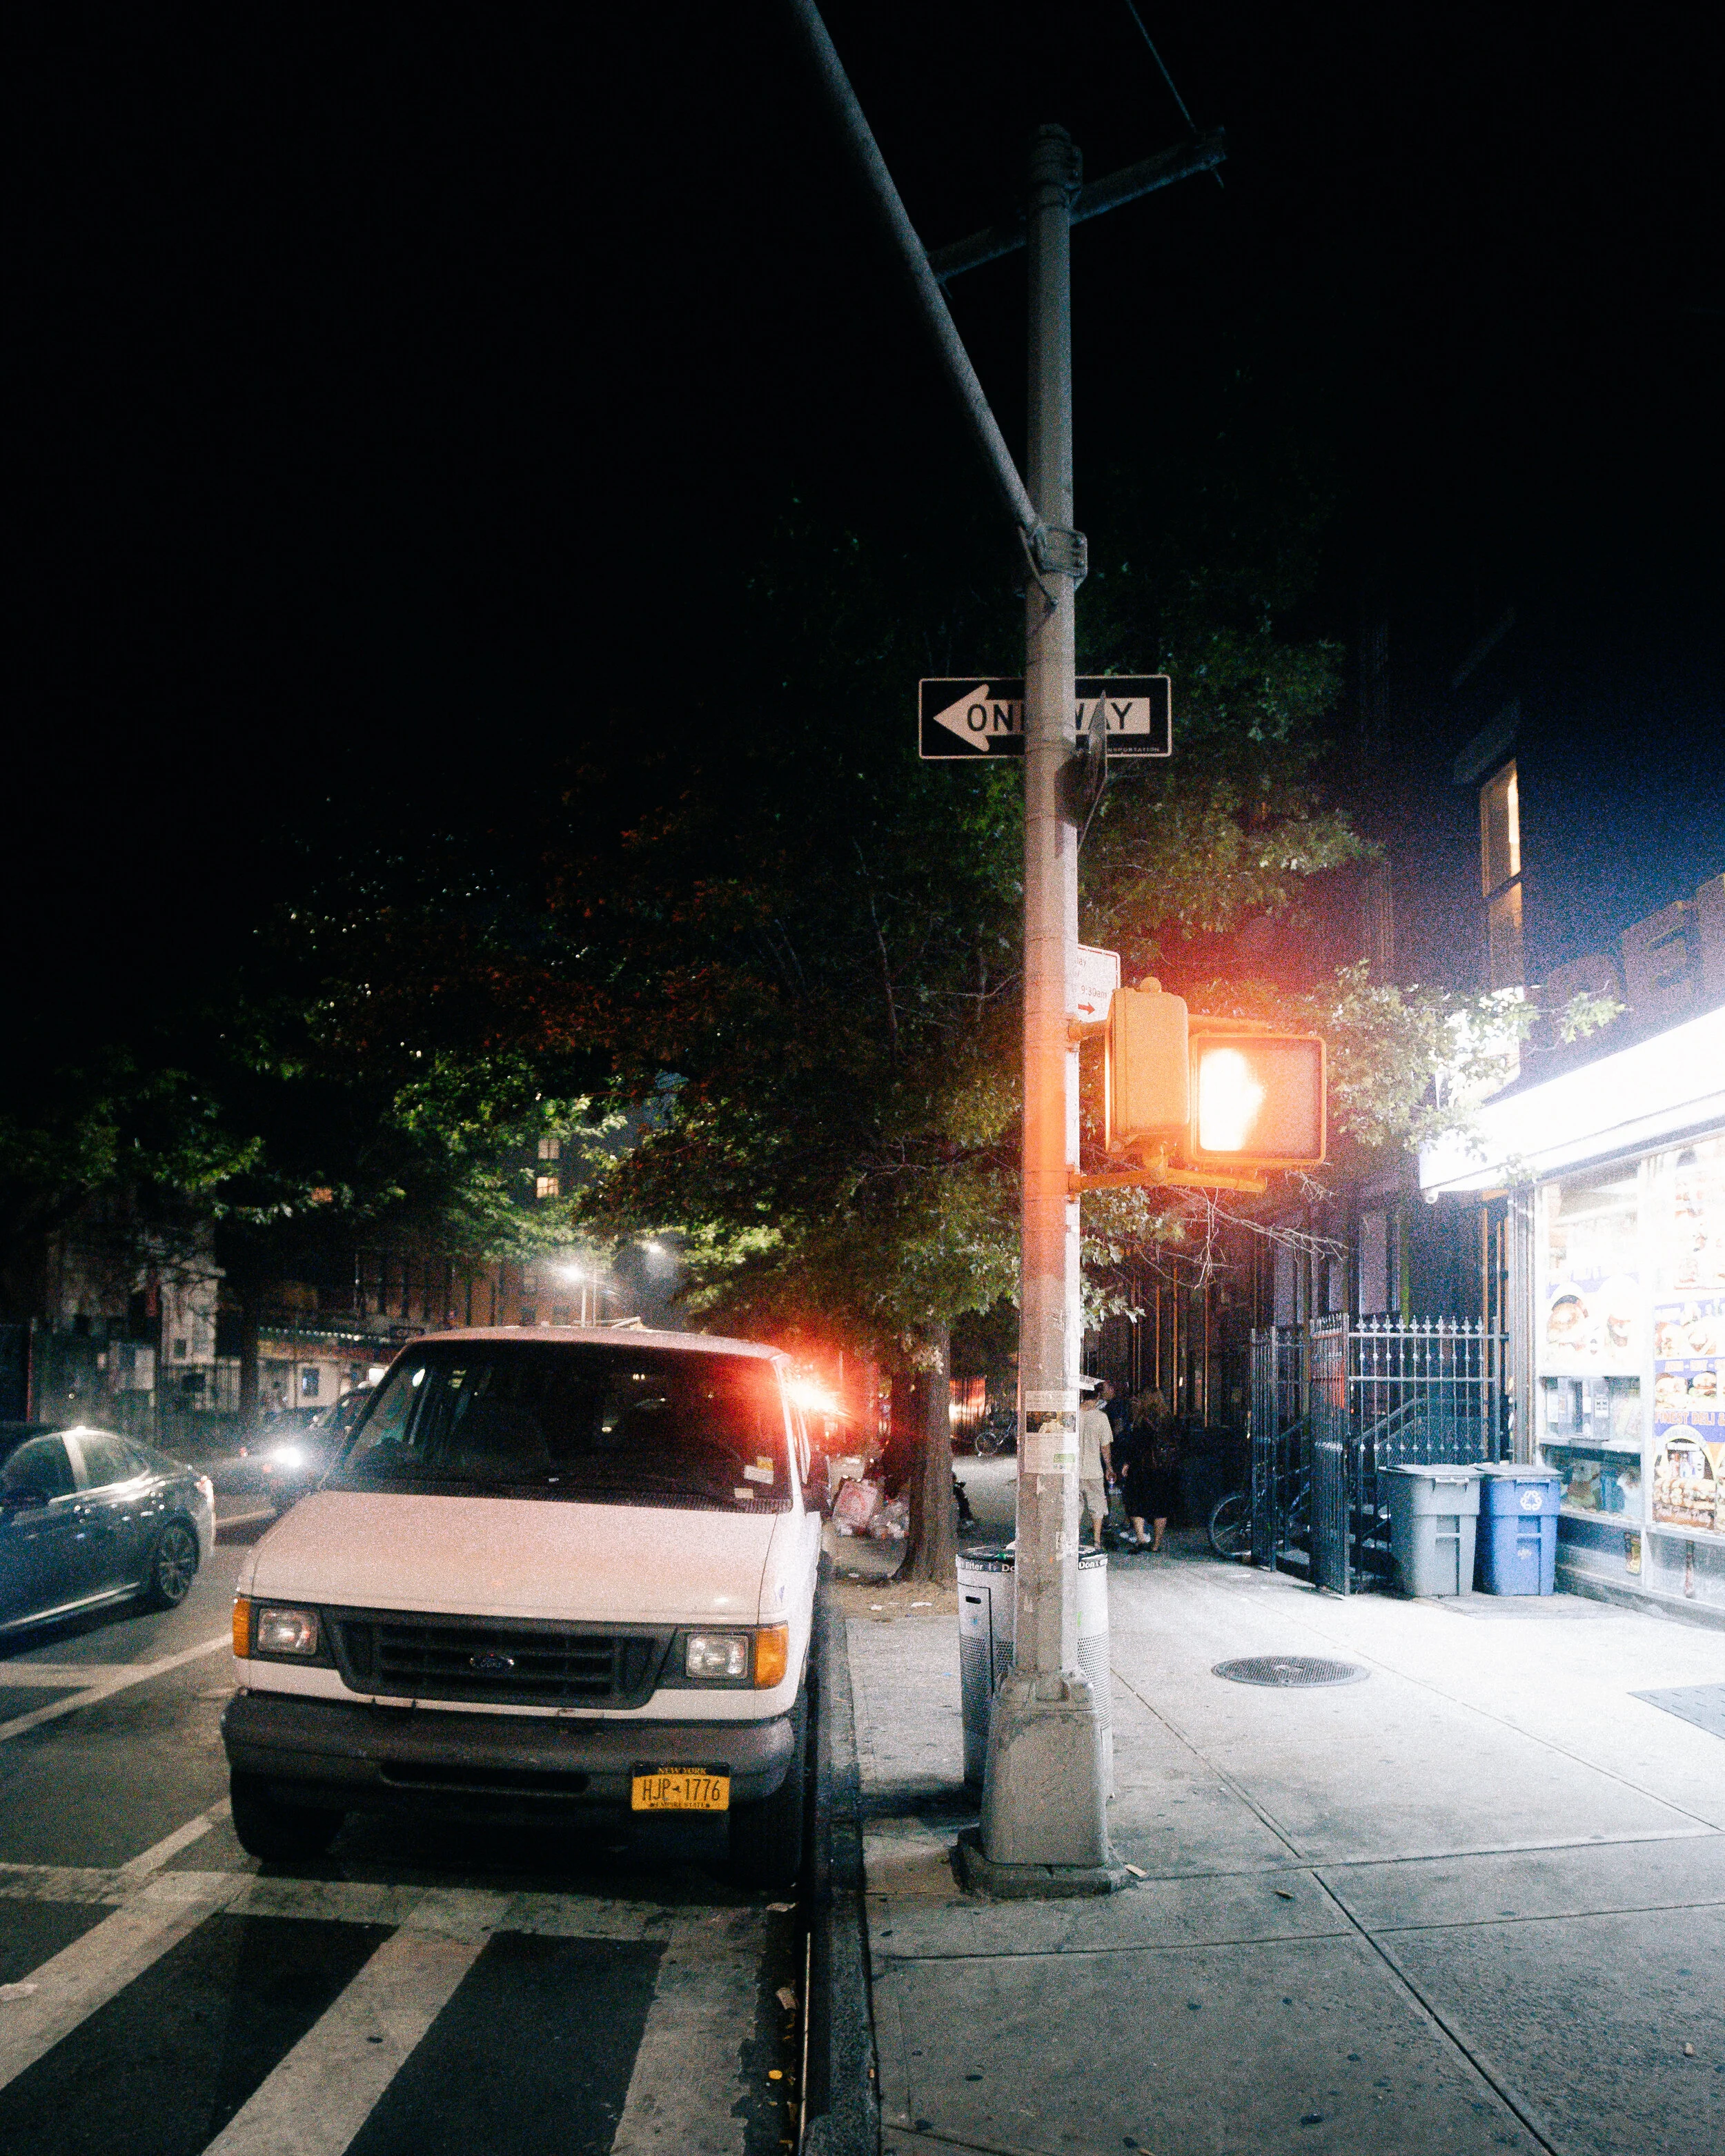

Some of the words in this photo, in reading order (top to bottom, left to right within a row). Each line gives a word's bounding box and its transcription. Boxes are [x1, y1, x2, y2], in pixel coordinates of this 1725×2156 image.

[967, 703, 1025, 731] ON
[1081, 985, 1107, 998] 9:30am
[1655, 1411, 1688, 1424] FINEST
[1691, 1412, 1715, 1426] DELI
[642, 1778, 671, 1801] HJP
[685, 1778, 721, 1801] 1776
